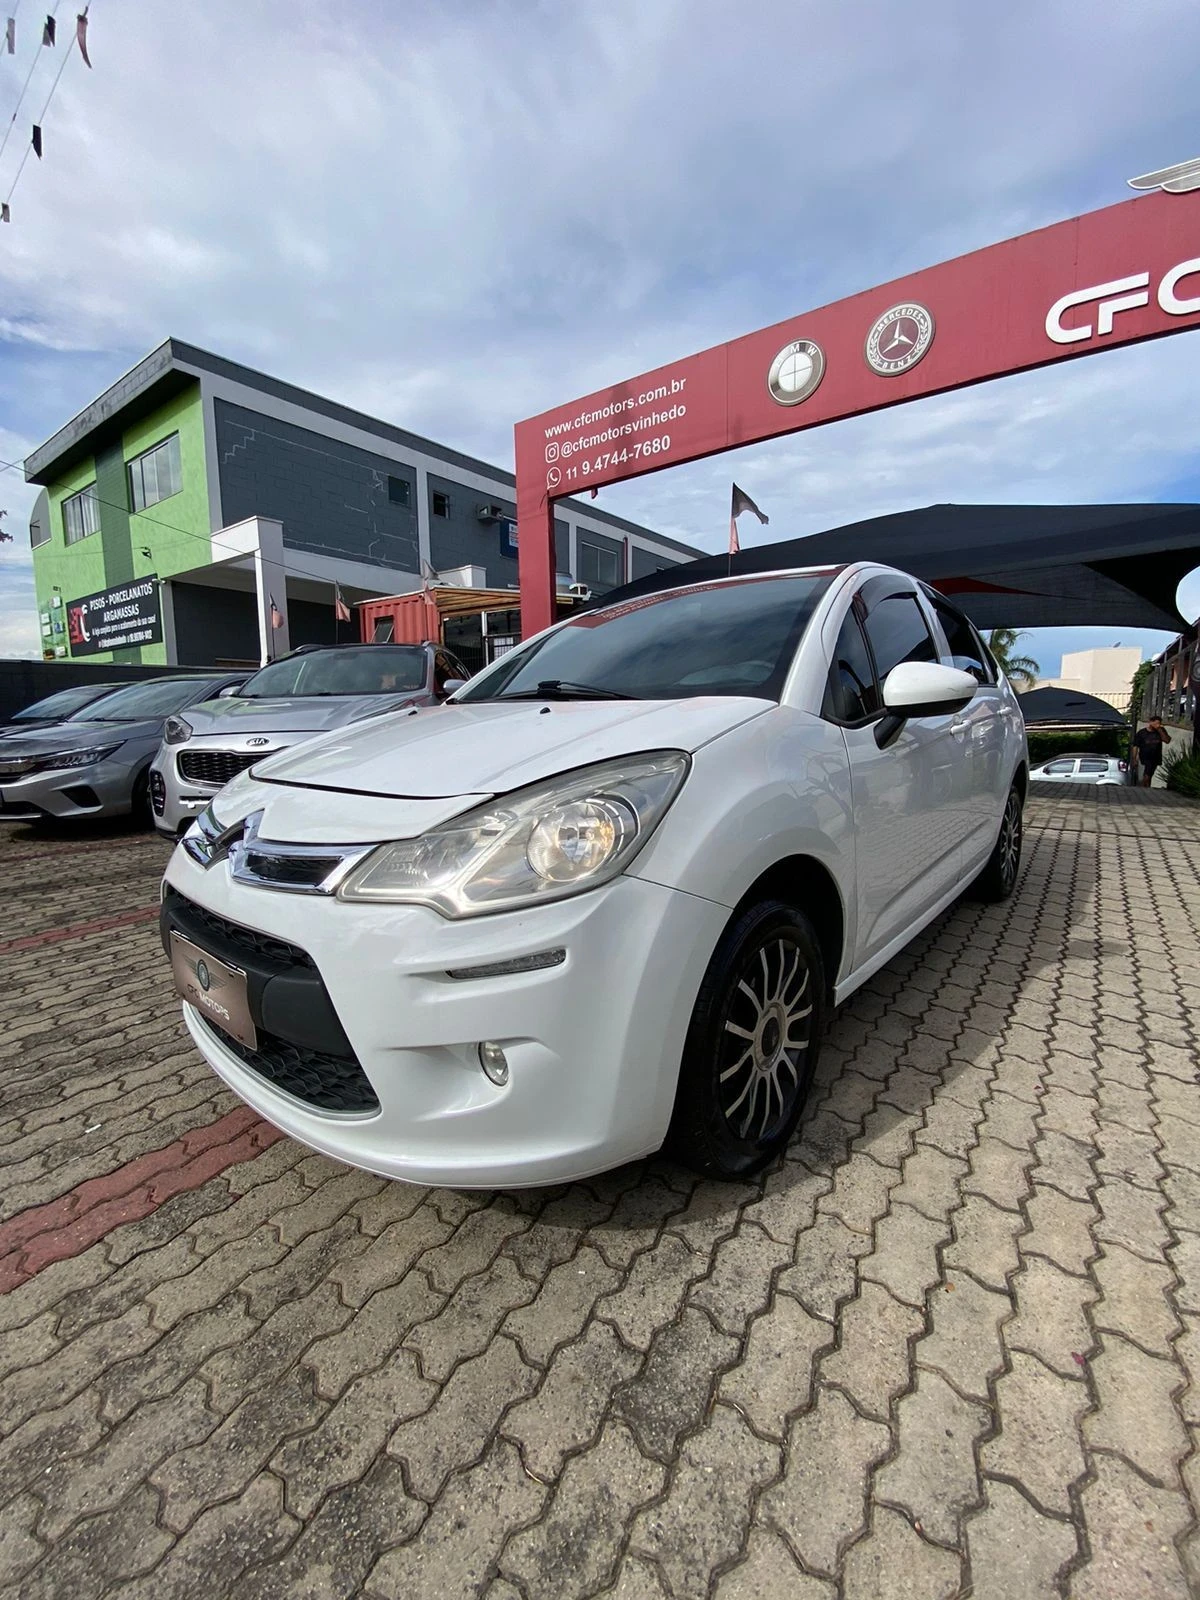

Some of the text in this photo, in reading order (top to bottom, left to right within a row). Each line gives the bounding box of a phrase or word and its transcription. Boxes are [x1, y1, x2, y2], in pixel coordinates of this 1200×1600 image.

[876, 308, 923, 332] MERCEDES
[882, 355, 914, 370] BENZ
[544, 378, 687, 438] www.cfcmotors.com.br
[561, 405, 686, 457] @cfcmotorsvinhedo
[565, 435, 671, 480] 11 9.4744-7680
[90, 597, 105, 611] PISOS
[109, 583, 153, 605] PORCELANATOS
[103, 604, 139, 622] ARGAMASSAS
[248, 737, 267, 746] KIA
[199, 991, 230, 1021] MOTORS
